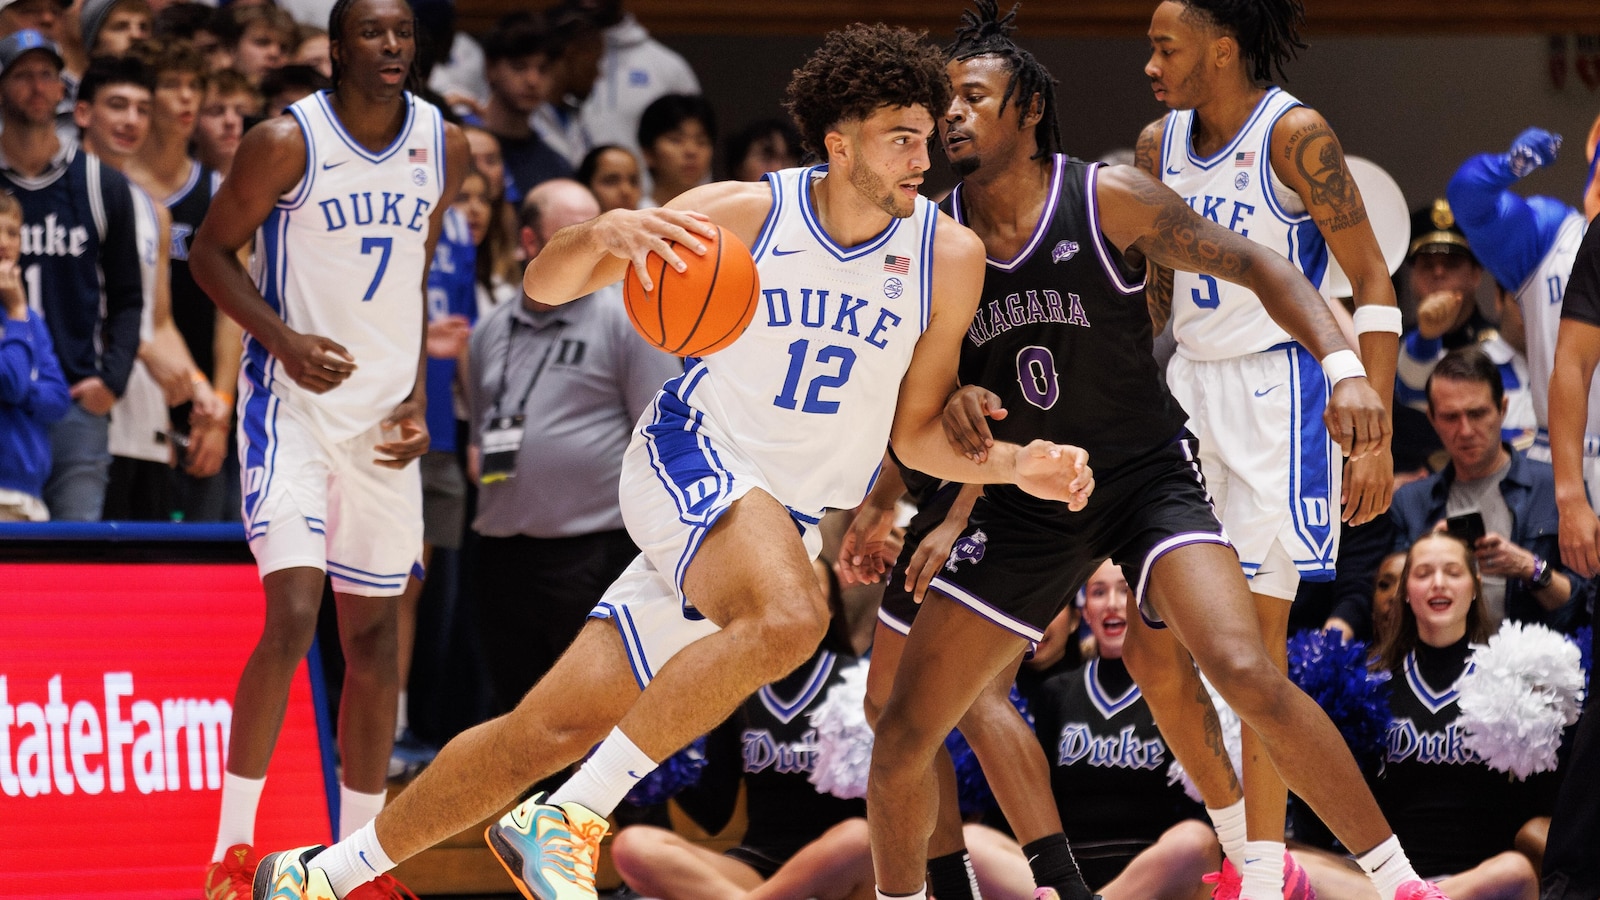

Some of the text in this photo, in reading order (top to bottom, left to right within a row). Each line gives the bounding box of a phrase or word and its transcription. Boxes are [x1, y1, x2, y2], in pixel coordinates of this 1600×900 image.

[20, 212, 89, 257] uke
[318, 192, 430, 232] DUKE
[361, 237, 393, 302] 7
[762, 288, 902, 350] DUKE
[773, 338, 857, 414] 12
[1016, 345, 1059, 411] 0
[1302, 497, 1329, 527] D
[0, 671, 233, 798] tateFarm
[1058, 722, 1166, 771] Duke
[1386, 718, 1483, 765] Duk
